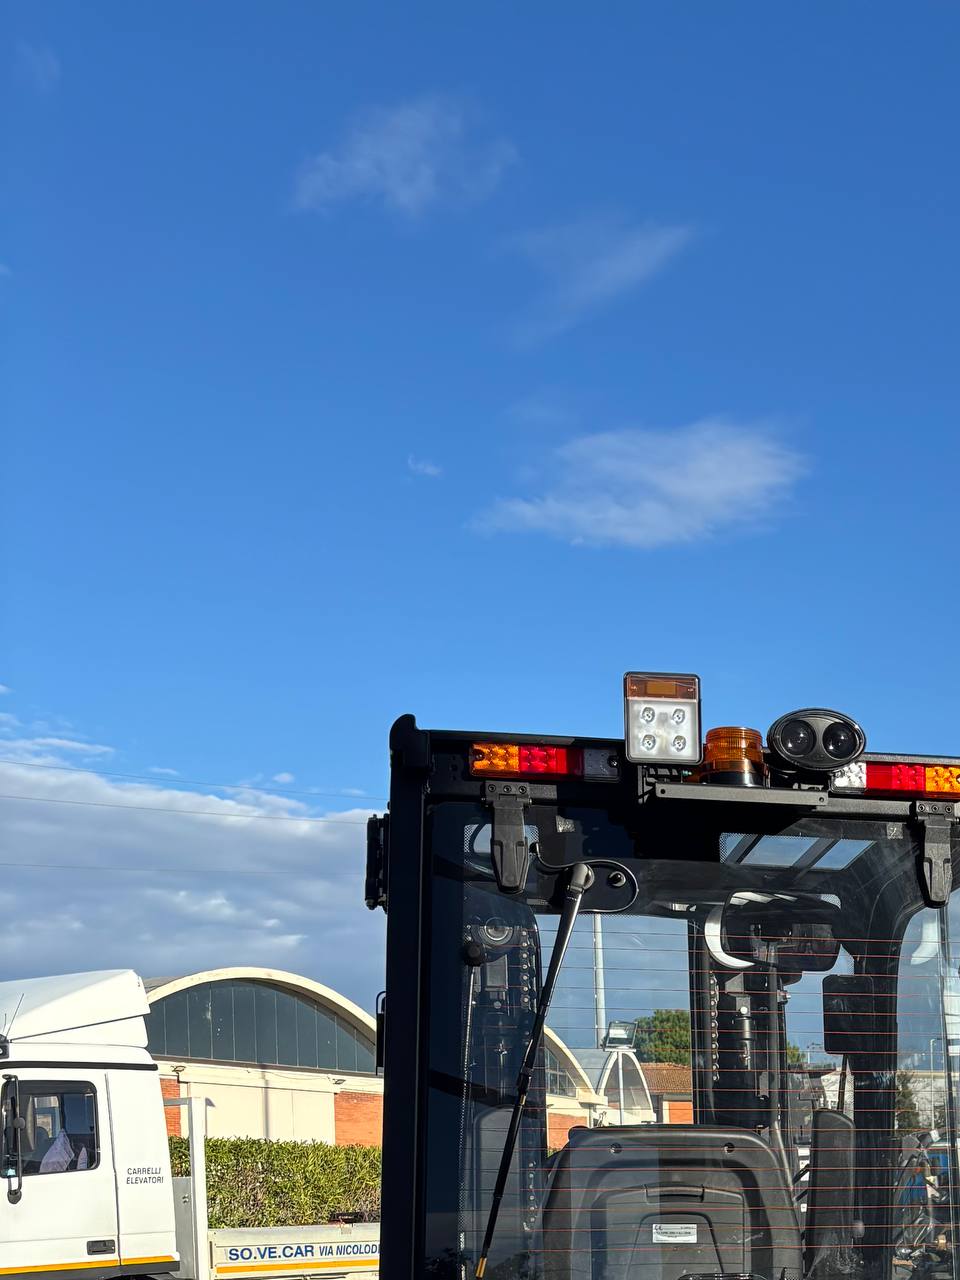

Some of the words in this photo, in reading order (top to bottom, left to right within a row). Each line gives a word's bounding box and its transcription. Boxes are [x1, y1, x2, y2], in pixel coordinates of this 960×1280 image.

[126, 1166, 162, 1176] CARRELLI
[126, 1175, 165, 1185] ELEVATORI
[228, 1245, 314, 1261] SO.VE.CAR
[319, 1245, 334, 1257] VIA
